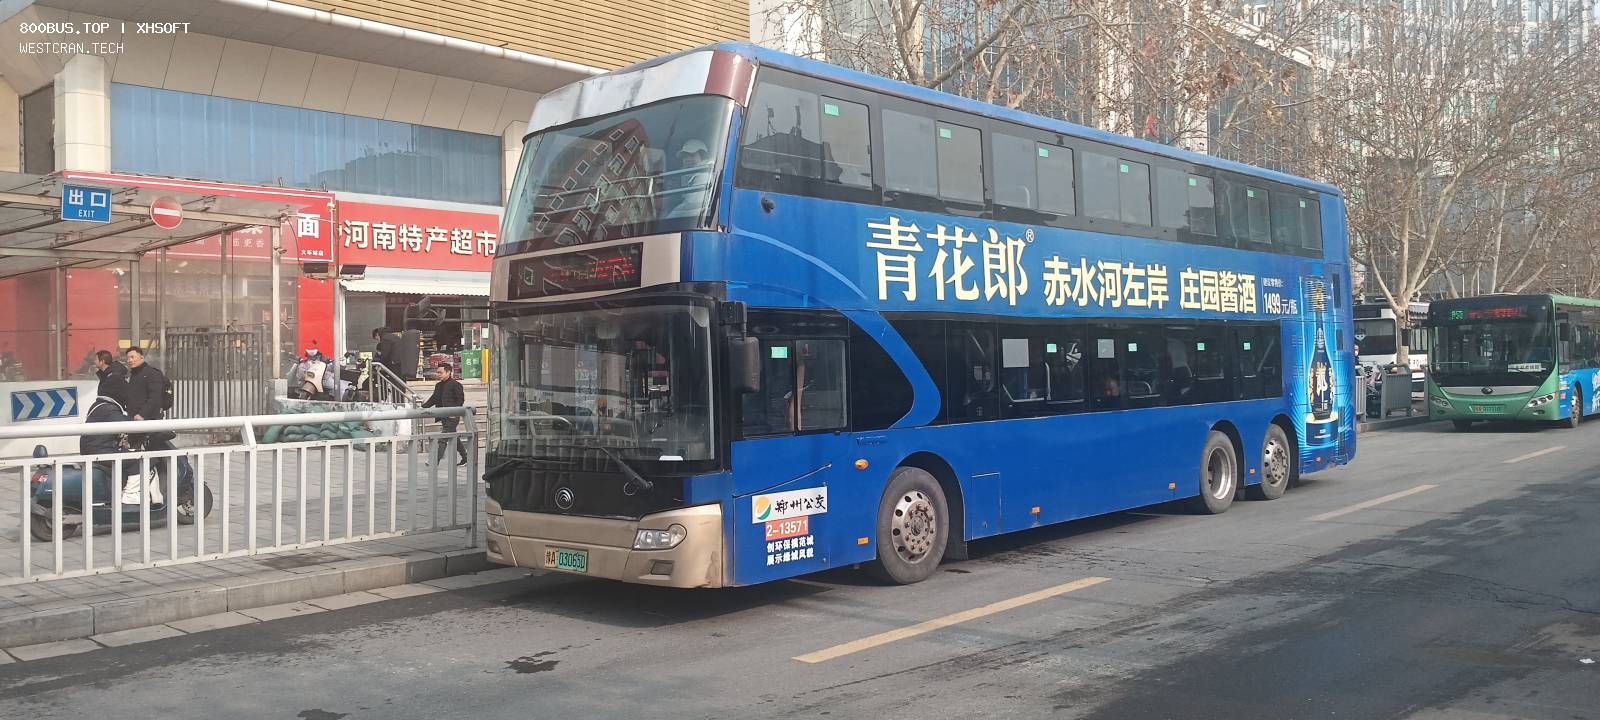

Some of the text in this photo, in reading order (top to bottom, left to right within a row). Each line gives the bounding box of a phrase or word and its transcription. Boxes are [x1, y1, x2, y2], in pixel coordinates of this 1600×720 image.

[68, 189, 107, 208] 出口
[78, 209, 95, 218] EXIT
[339, 219, 497, 257] 河南特产超市
[866, 216, 1028, 306] 青花郎
[1042, 255, 1170, 309] 赤水河左岸
[1180, 267, 1257, 314] 庄园酱酒
[774, 494, 826, 515] 郑州公交
[766, 520, 808, 537] 2-13571
